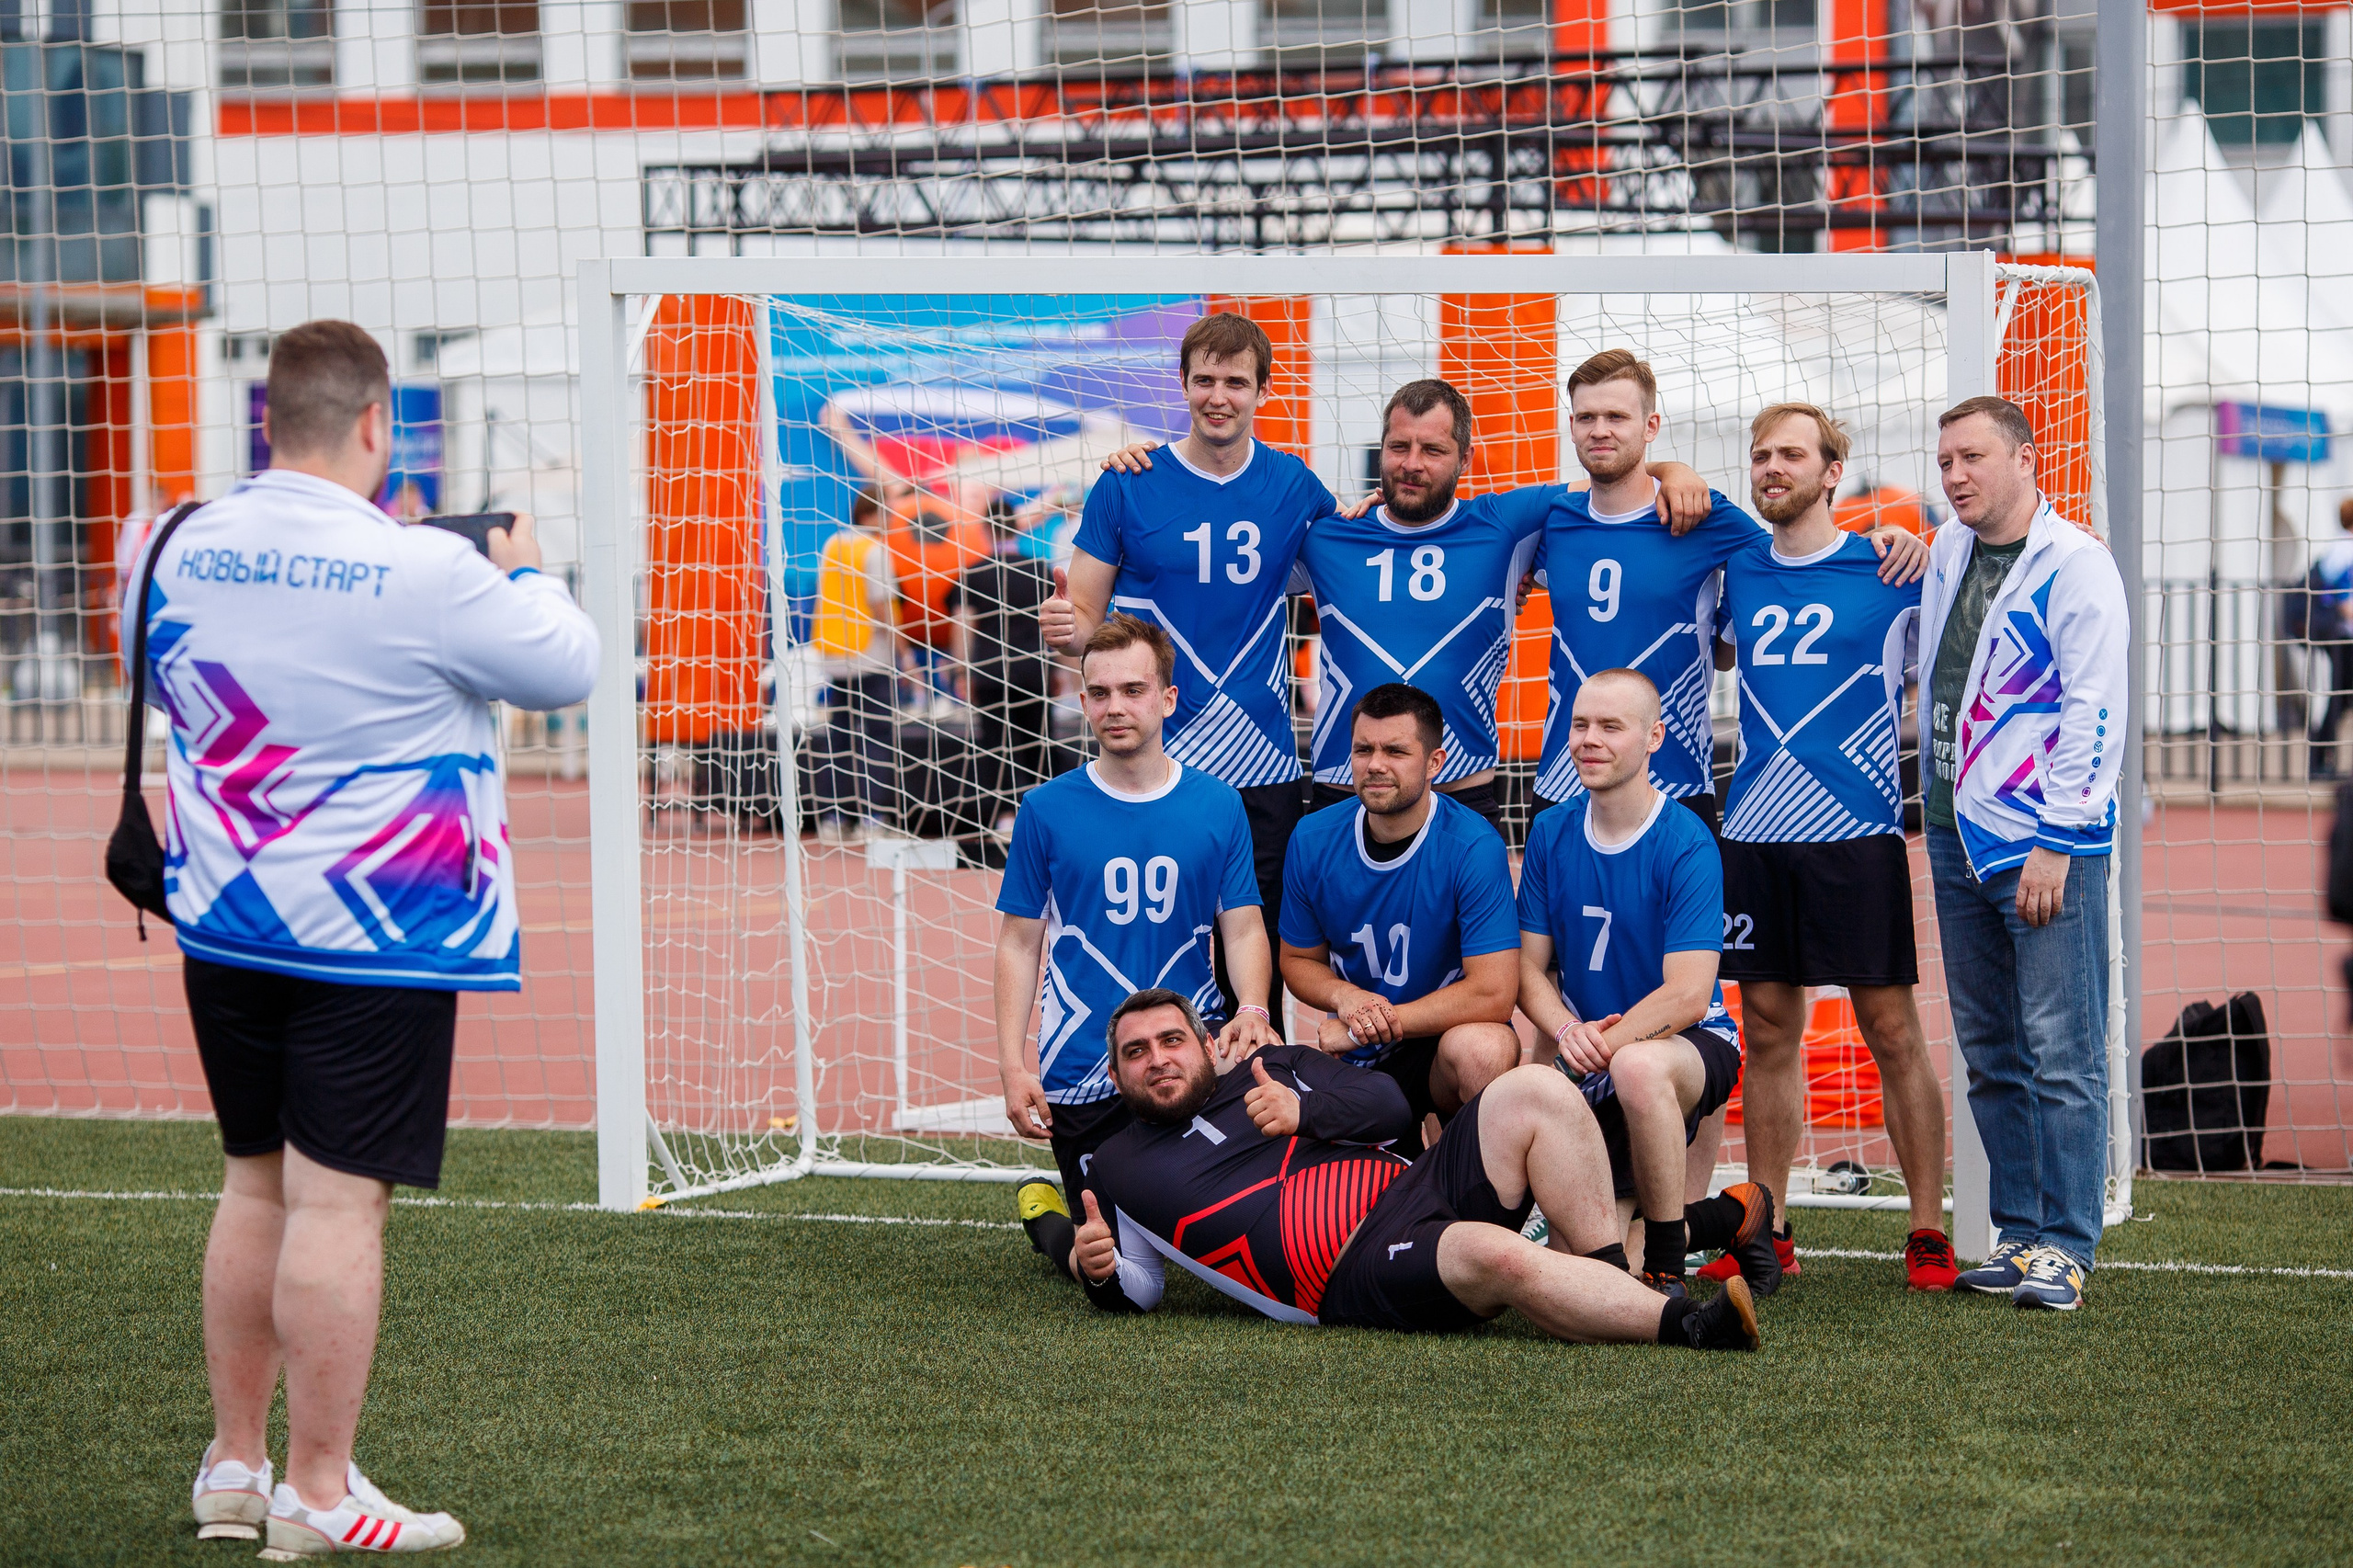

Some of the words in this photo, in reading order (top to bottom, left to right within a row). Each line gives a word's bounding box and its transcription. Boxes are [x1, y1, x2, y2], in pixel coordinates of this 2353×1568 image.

[176, 548, 281, 585] НОВЫЙ
[285, 555, 391, 598] СТАРТ
[1183, 520, 1262, 585] 13
[1366, 544, 1447, 602] 18
[1587, 558, 1622, 623] 9
[1751, 603, 1835, 666] 22
[1103, 855, 1179, 926] 99
[1350, 922, 1411, 987] 10
[1582, 904, 1612, 971] 7
[1722, 912, 1755, 950] 22
[1182, 1114, 1228, 1146] 1
[1387, 1241, 1414, 1261] 1
